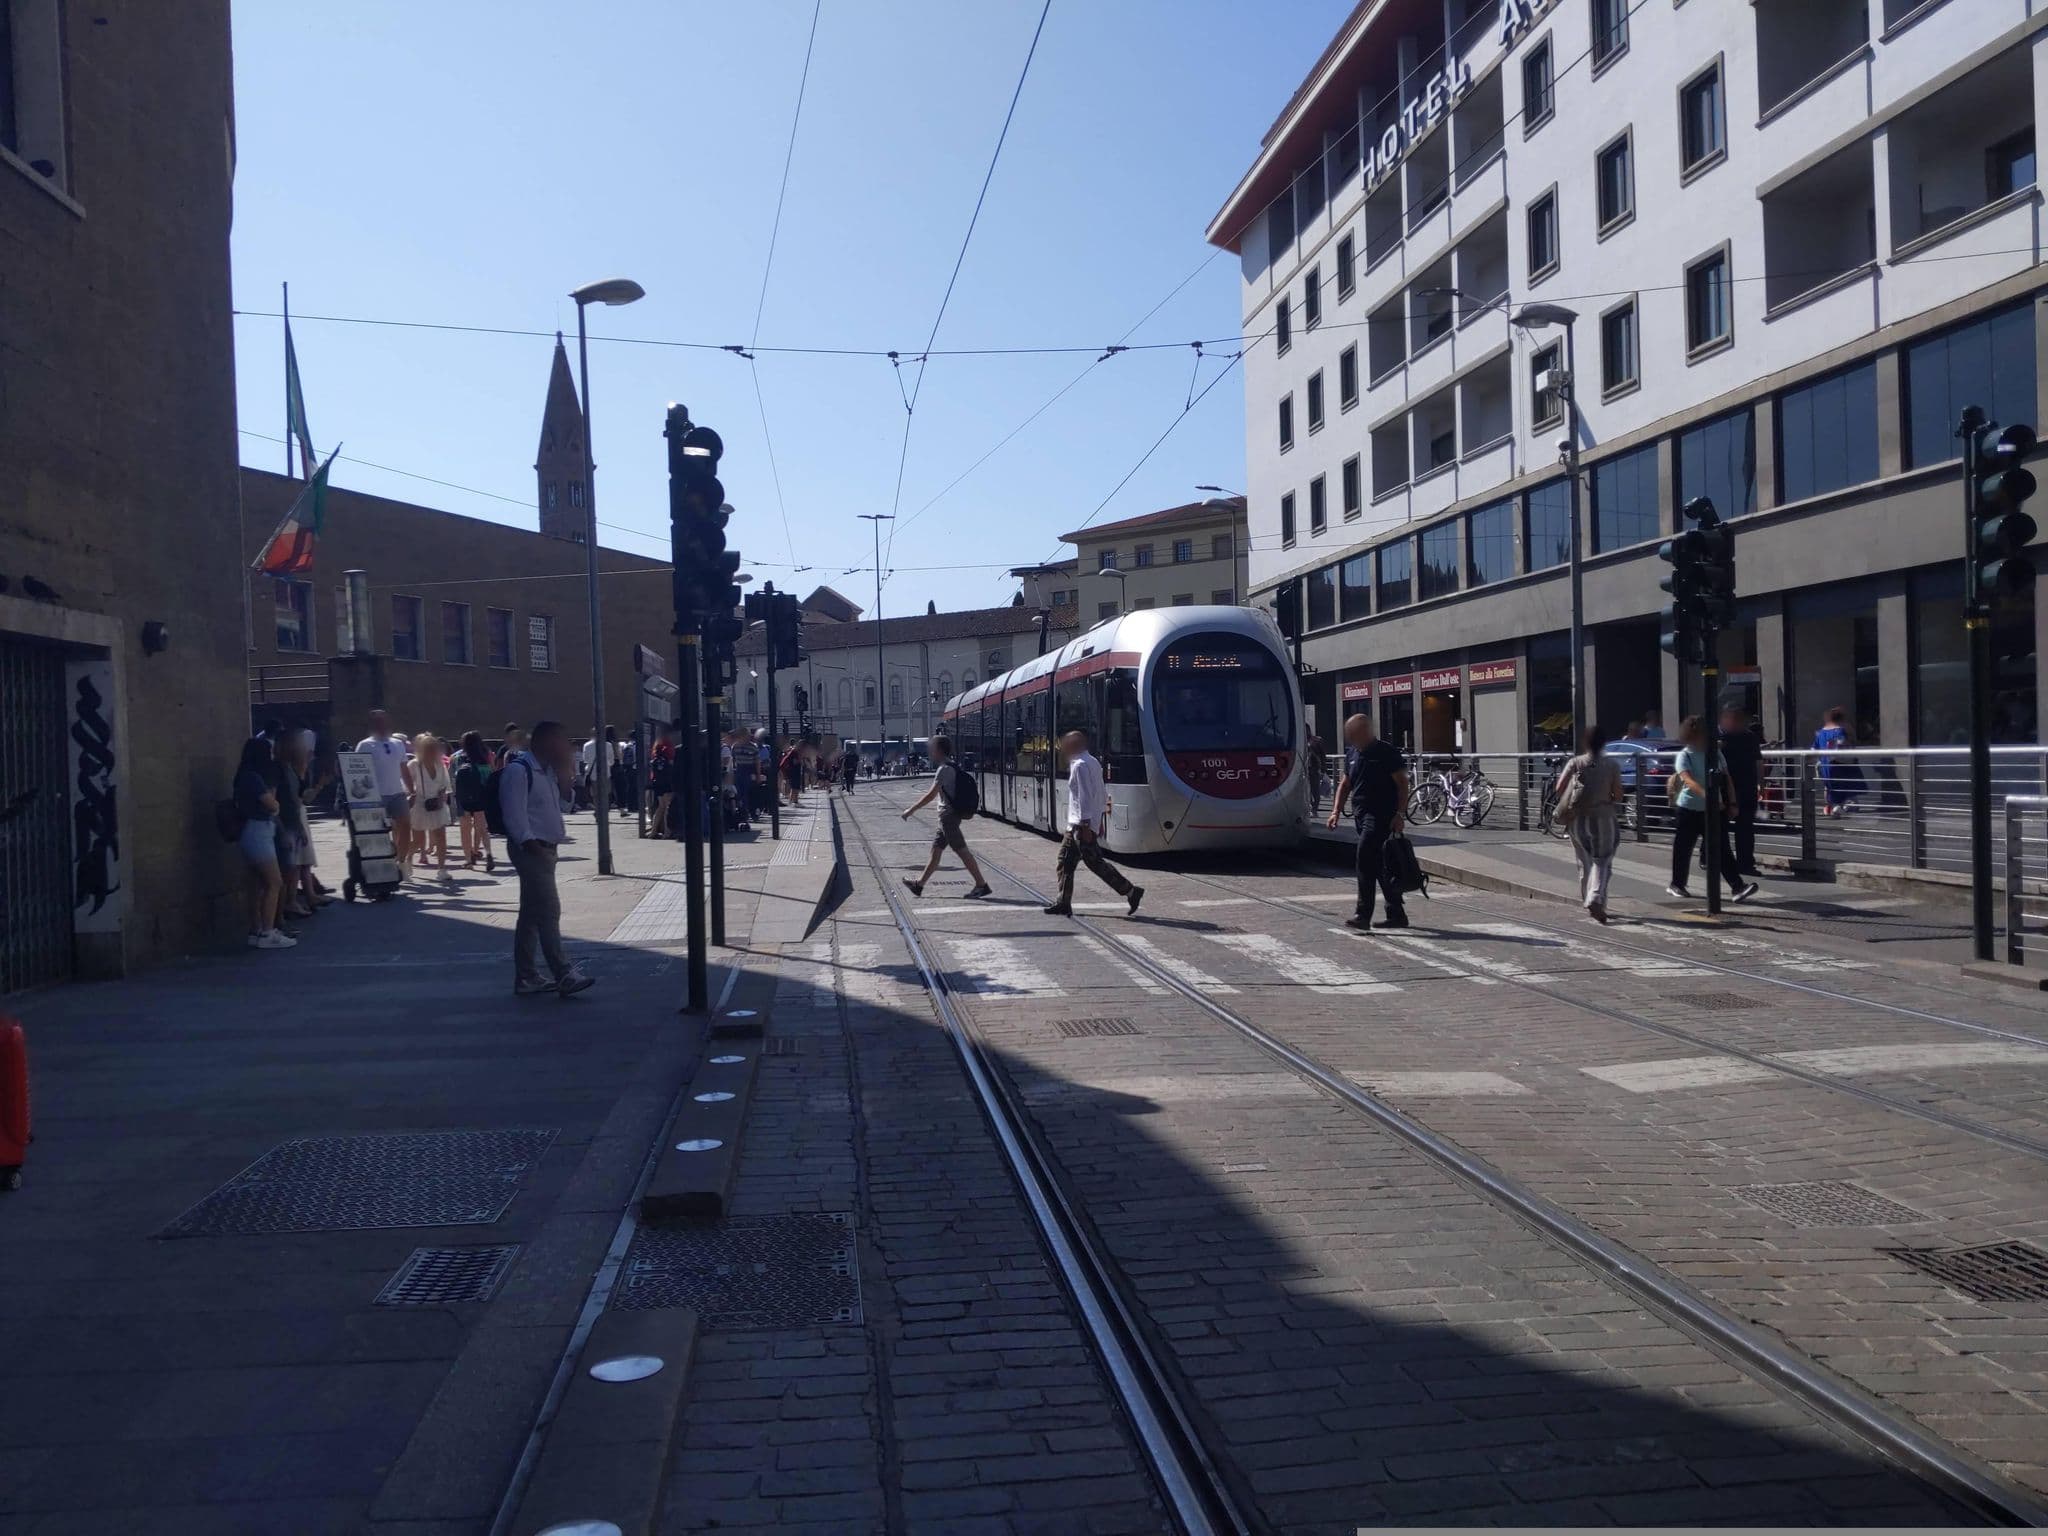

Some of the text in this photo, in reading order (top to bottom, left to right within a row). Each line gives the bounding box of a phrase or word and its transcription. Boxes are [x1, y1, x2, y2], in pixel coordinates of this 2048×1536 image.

[1360, 56, 1472, 191] HOTEL
[1379, 680, 1412, 694] Cucina Toscana
[1201, 759, 1227, 768] 1001
[1216, 769, 1250, 780] GEST
